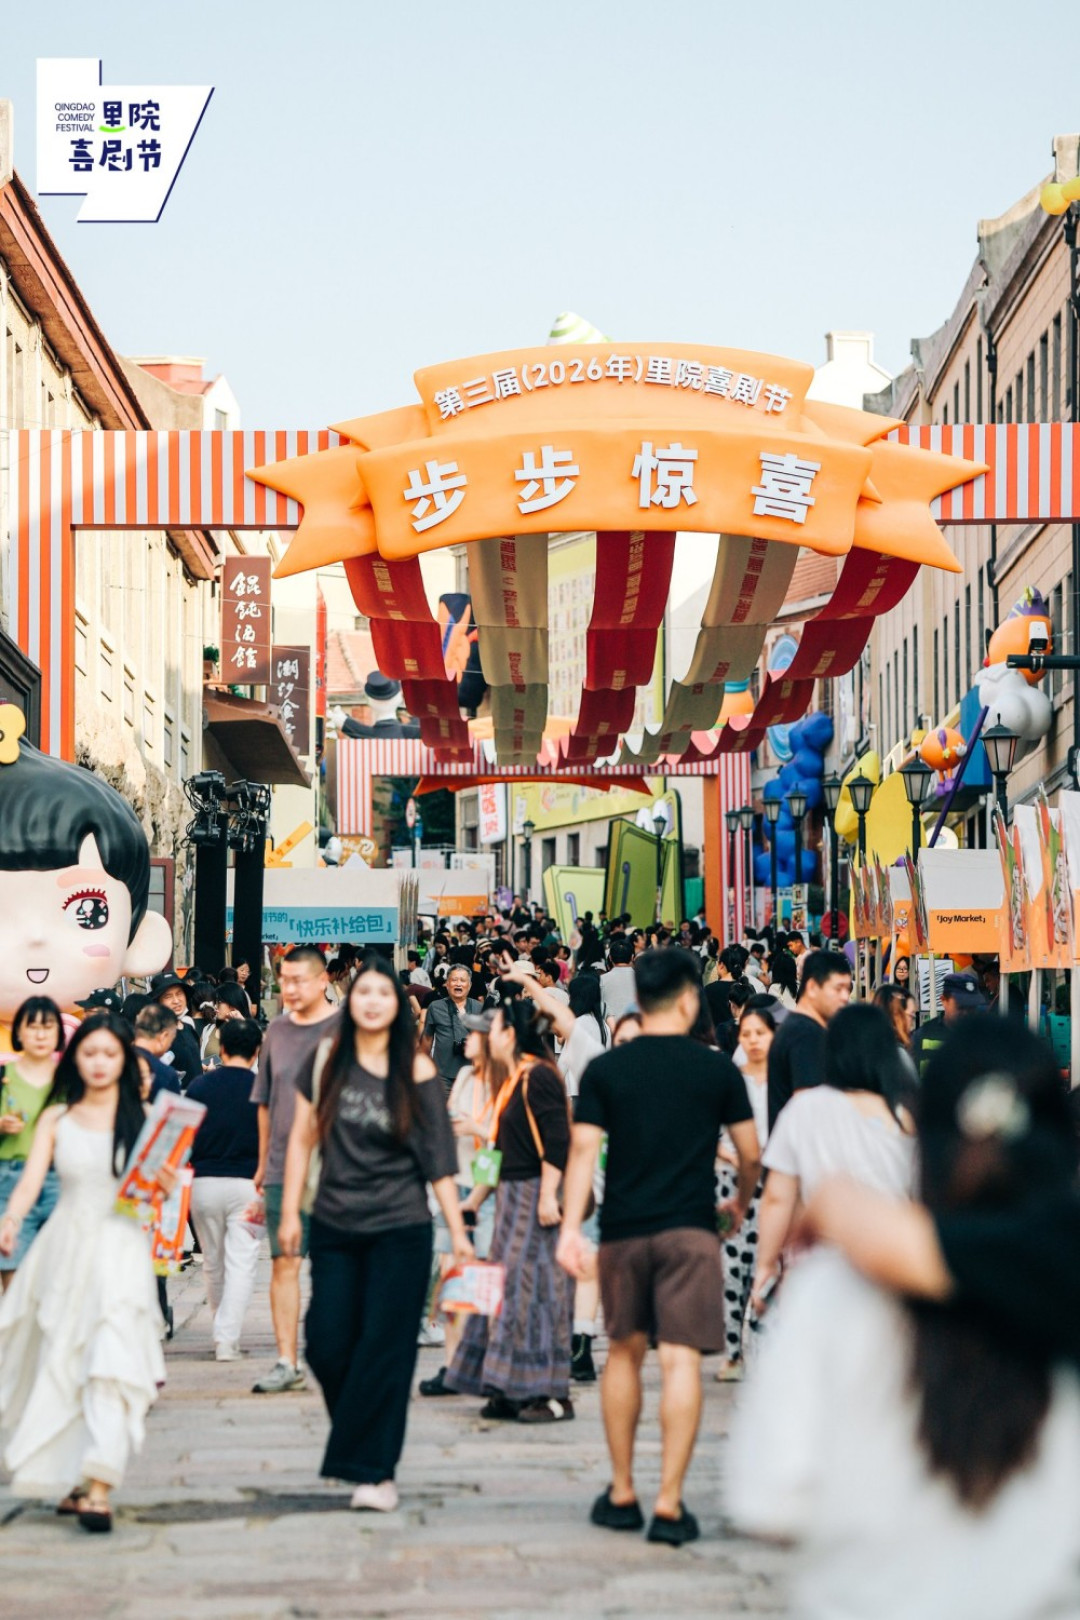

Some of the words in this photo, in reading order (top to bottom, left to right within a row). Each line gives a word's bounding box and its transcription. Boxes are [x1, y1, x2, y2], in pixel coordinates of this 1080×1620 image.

[433, 353, 794, 419] 第三届(2026年)里院喜剧节
[403, 441, 821, 533] 步步惊喜
